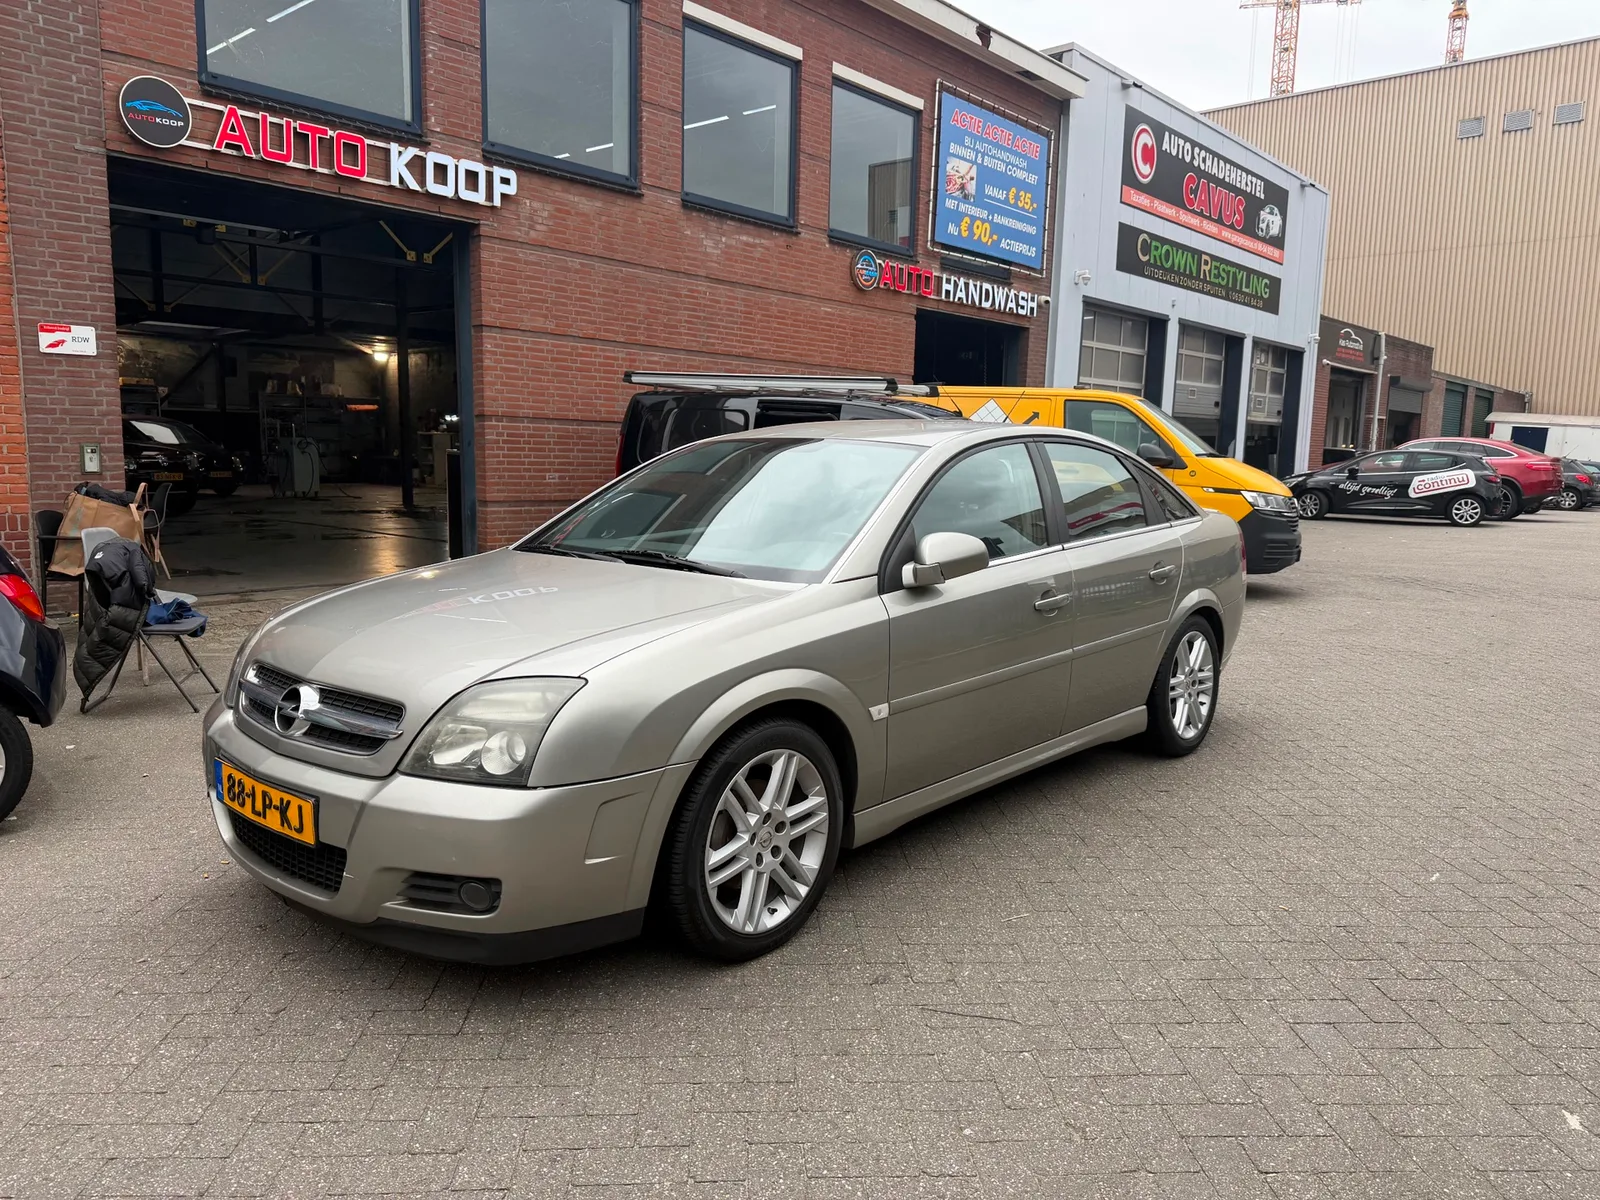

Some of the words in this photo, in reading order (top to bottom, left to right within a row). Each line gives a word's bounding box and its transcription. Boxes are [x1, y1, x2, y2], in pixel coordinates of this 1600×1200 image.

[950, 108, 983, 136] ACTIE
[983, 122, 1014, 149] ACTIE
[1013, 135, 1041, 160] ACTIE
[964, 136, 974, 148] BIJ
[975, 140, 1028, 169] AUTOHANDWASH
[213, 104, 368, 179] AUTO
[390, 142, 517, 207] KOOP
[949, 142, 976, 161] BINNEN
[976, 153, 983, 164] &
[984, 155, 1006, 173] BUITEN
[1006, 165, 1039, 185] COMPLEET
[1162, 131, 1192, 163] AUTO
[1193, 147, 1265, 200] SCHADEHERSTEL
[984, 184, 1007, 201] VANAF
[1009, 187, 1017, 205] €
[1130, 190, 1150, 207] Taxaties
[1153, 199, 1176, 217] Plaatwerk
[1179, 210, 1200, 227] Spuitwerk
[1183, 172, 1246, 230] CAVUS
[945, 198, 957, 210] MET
[958, 202, 988, 220] INTERIEUR
[993, 213, 1037, 235] BANKREINIGING
[947, 222, 959, 236] Nu
[960, 216, 971, 238] €
[999, 238, 1037, 257] ACTIEPRIJS
[1137, 233, 1198, 277] CROWN
[1200, 253, 1270, 299] RESTYLING
[1144, 265, 1180, 284] UITDEUKEN
[1180, 276, 1203, 291] ZONDER
[1203, 283, 1226, 297] SPUITEN
[879, 259, 935, 297] AUTO
[942, 273, 1038, 318] HANDWASH
[1338, 480, 1361, 495] altijd
[1416, 475, 1467, 491] continu
[1427, 474, 1446, 482] radio
[226, 772, 304, 834] 88-LP-KJ
